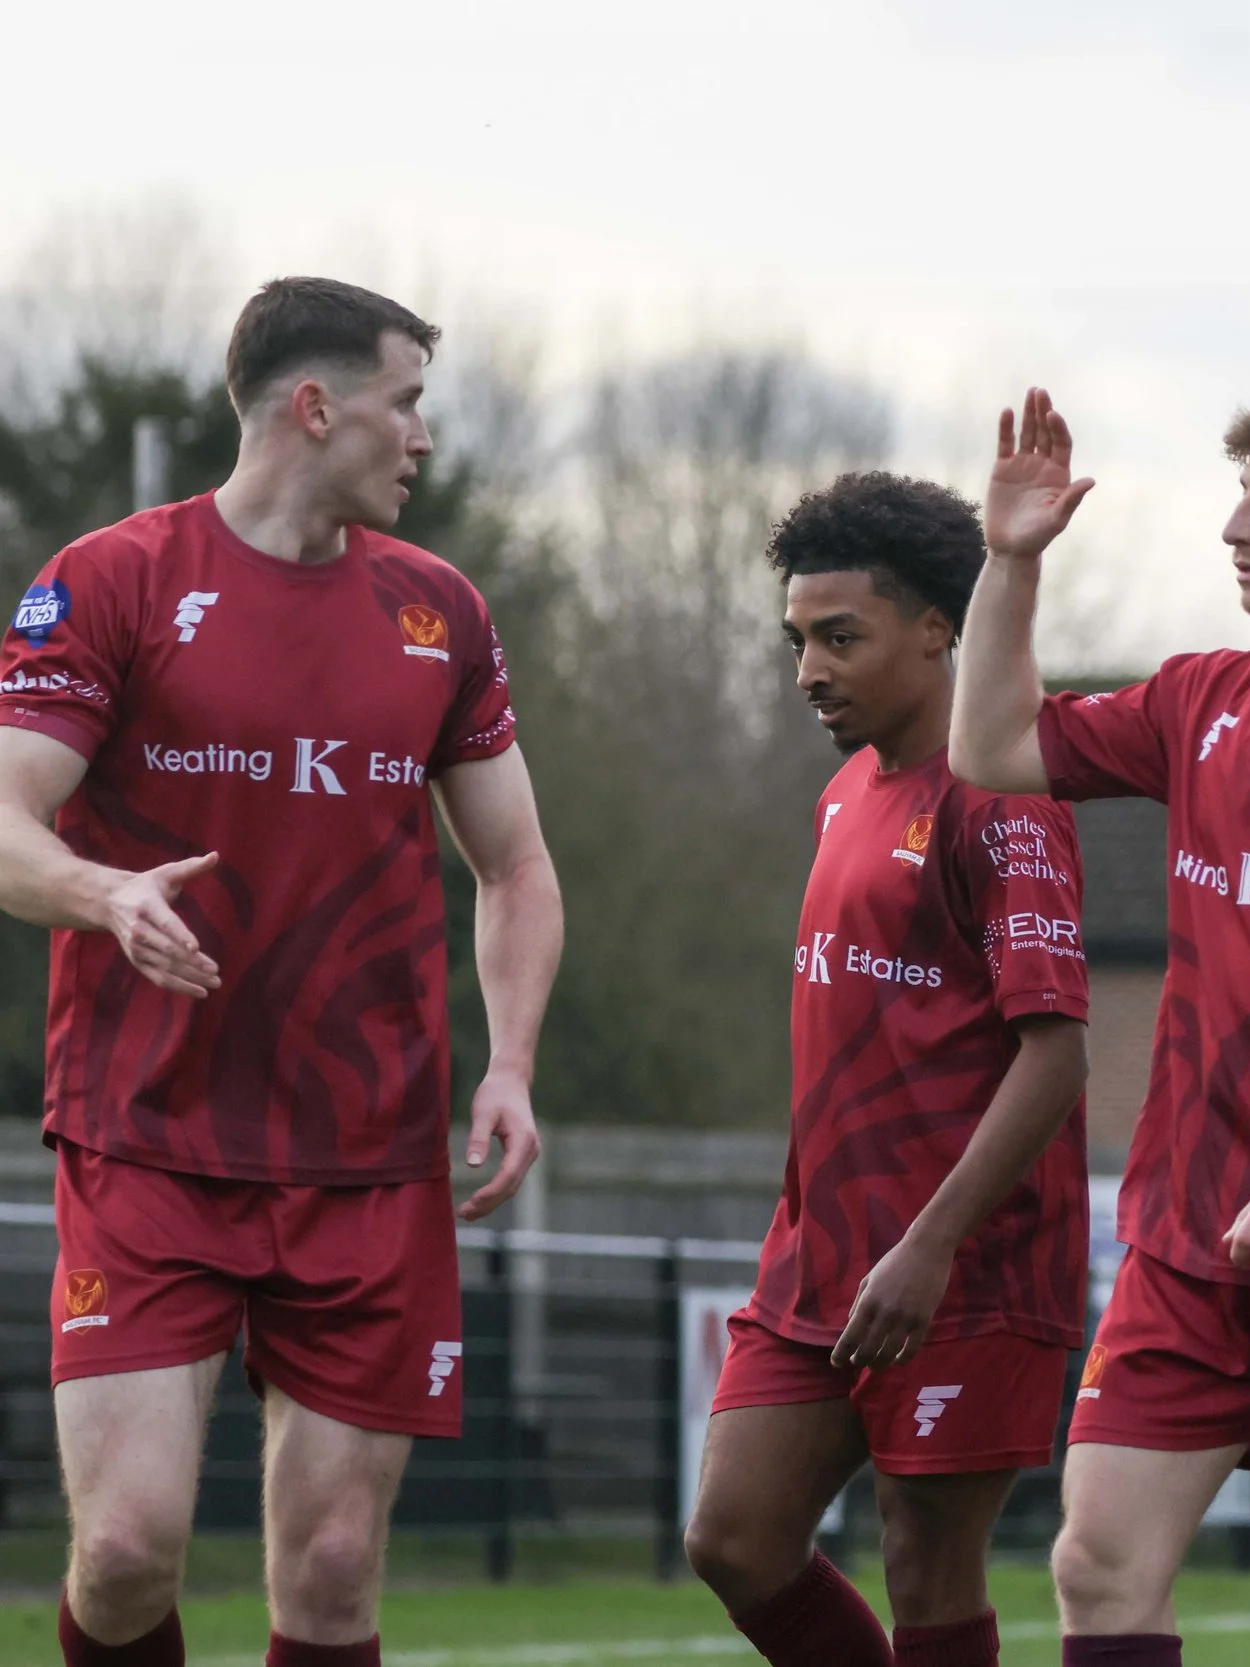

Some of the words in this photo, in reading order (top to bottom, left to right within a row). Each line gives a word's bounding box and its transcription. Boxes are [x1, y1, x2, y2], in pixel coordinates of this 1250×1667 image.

[19, 604, 55, 626] NHS
[143, 743, 272, 781] Keating
[290, 737, 348, 795] K
[368, 752, 425, 788] Esta
[981, 815, 1046, 845] Charles
[1008, 912, 1076, 945] EDR
[808, 932, 836, 985] K
[846, 944, 943, 988] Estates
